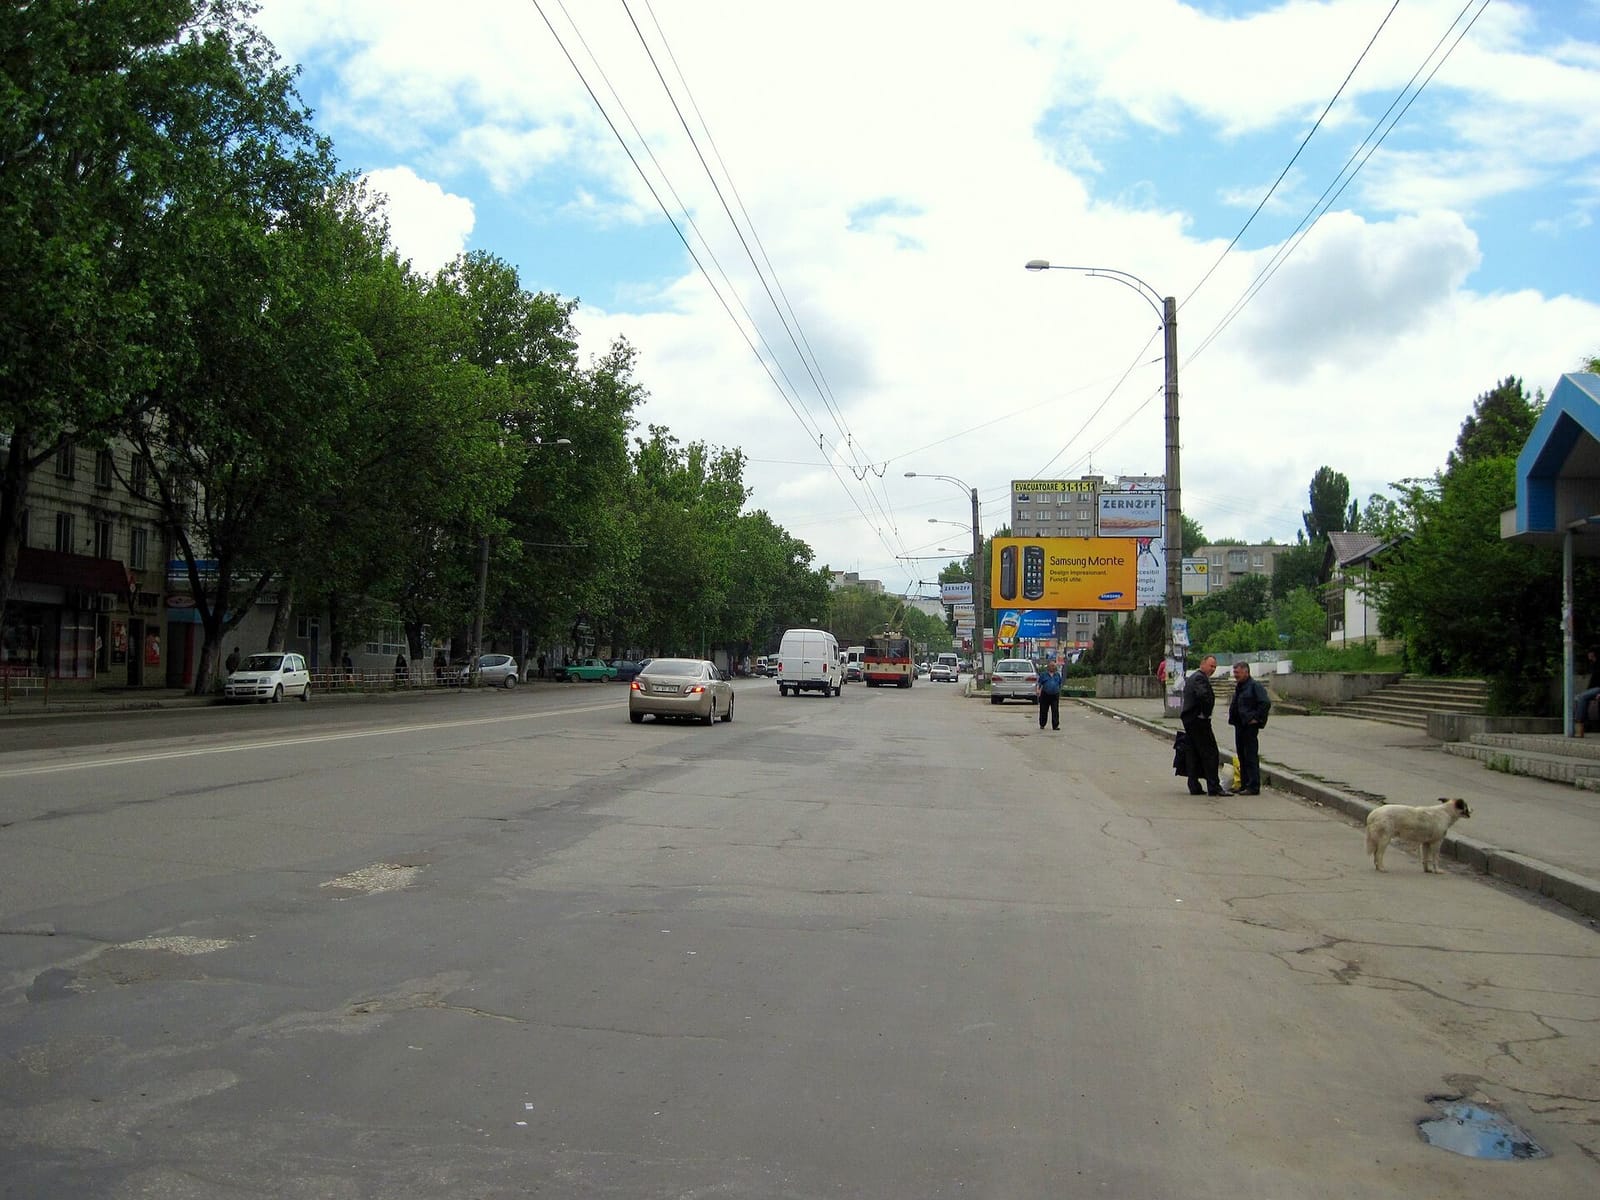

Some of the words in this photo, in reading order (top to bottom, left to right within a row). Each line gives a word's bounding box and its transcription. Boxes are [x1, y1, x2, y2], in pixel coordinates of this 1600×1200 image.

[1015, 483, 1058, 491] EVACUATOARE
[1050, 555, 1087, 568] Samsung
[1088, 556, 1125, 566] Monte
